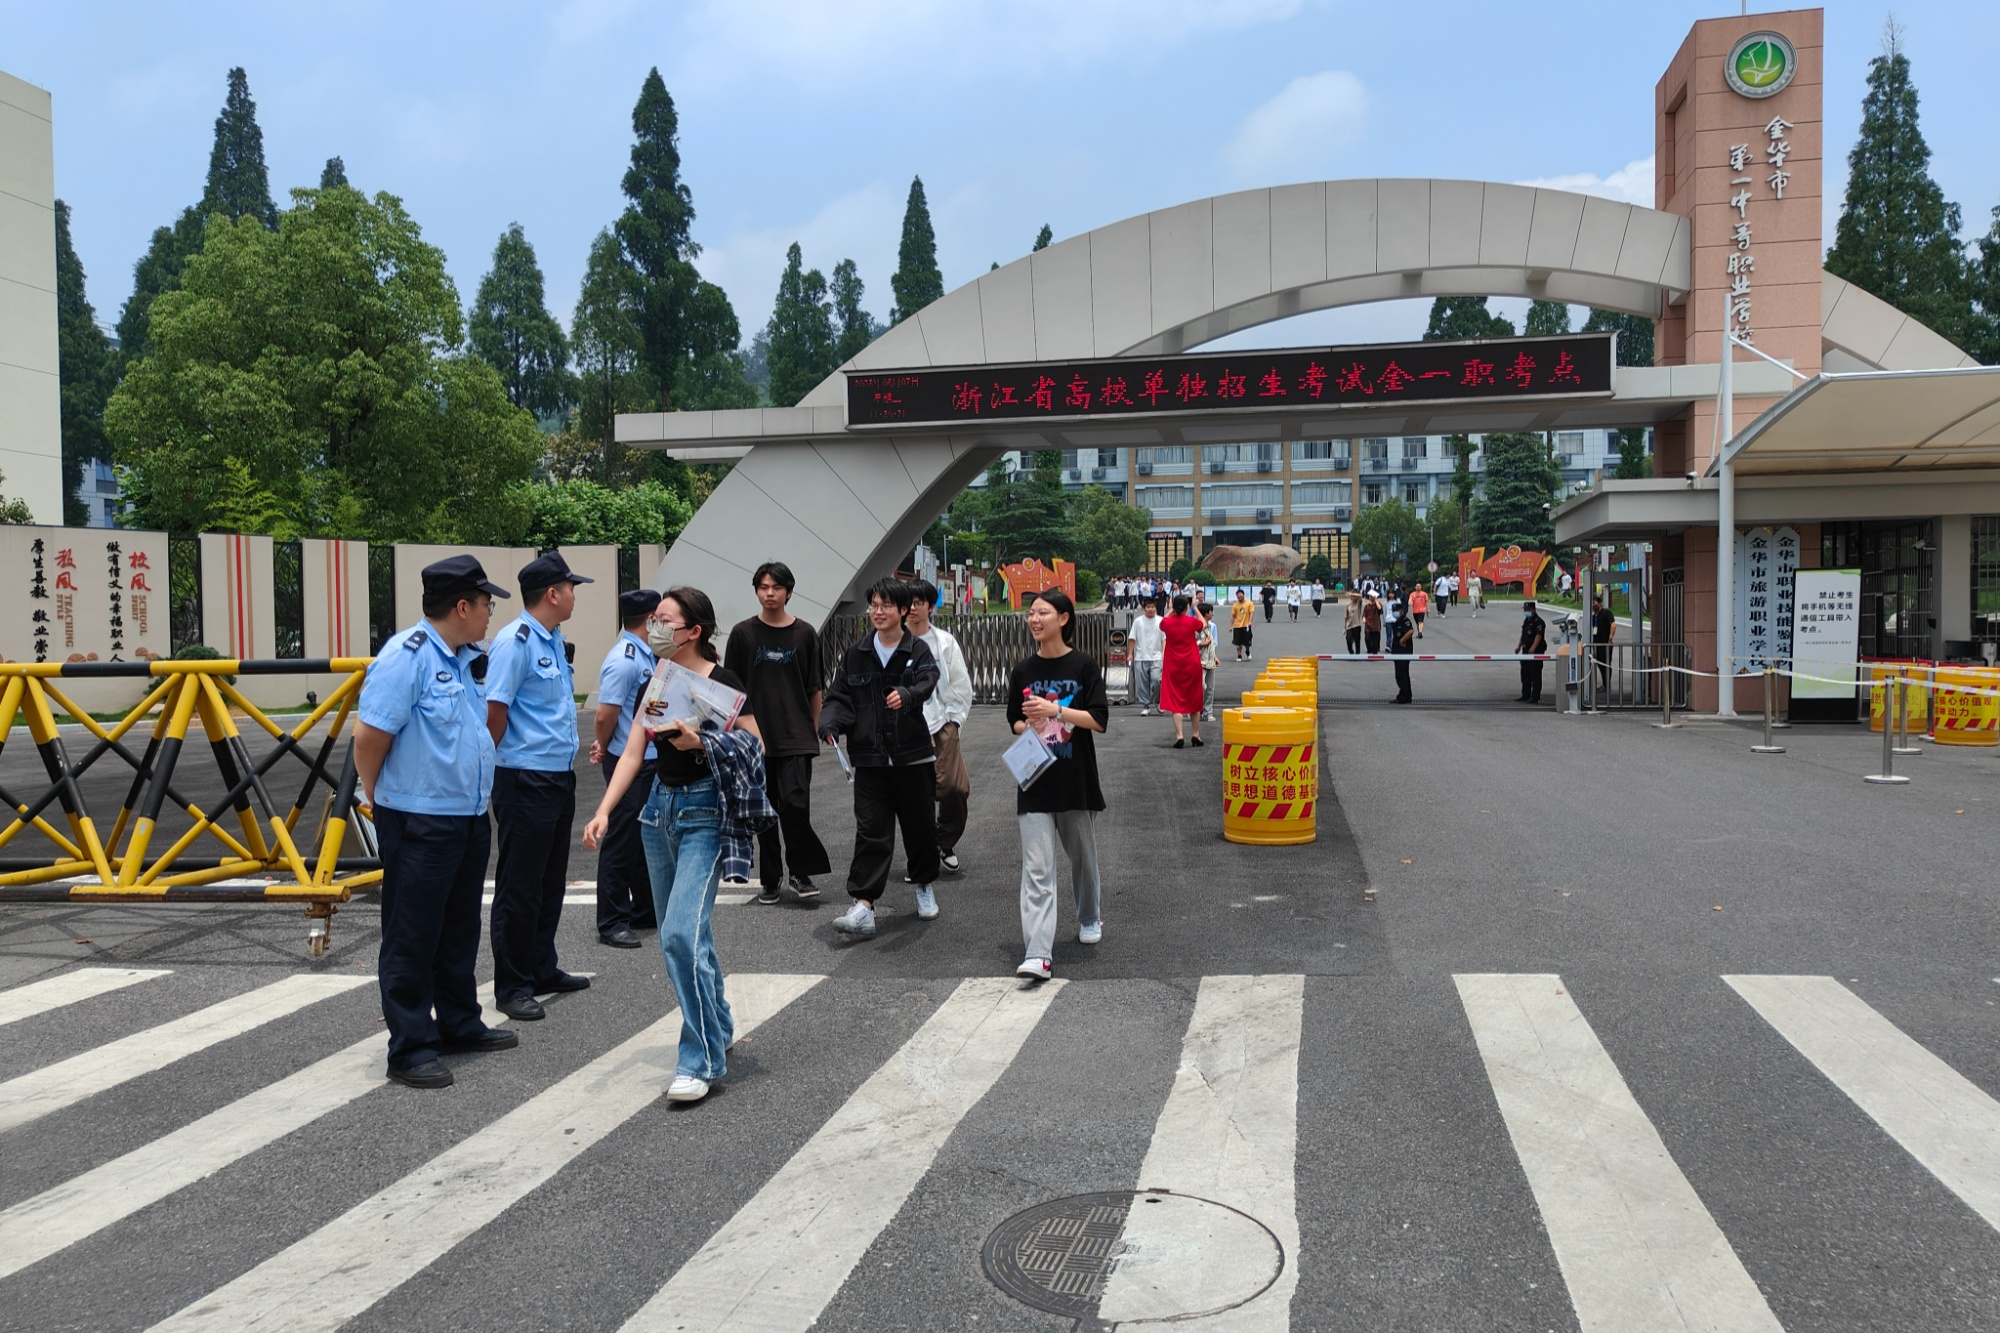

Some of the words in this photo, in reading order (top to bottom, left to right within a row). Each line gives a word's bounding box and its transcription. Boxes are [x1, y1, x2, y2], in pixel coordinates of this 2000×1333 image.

[1764, 115, 1794, 200] 金华市
[1727, 143, 1755, 346] 第一中等职业学校
[30, 538, 49, 599] 厚生善教
[54, 548, 78, 591] 教风
[128, 551, 151, 591] 校风
[1819, 591, 1853, 599] 禁止考生
[64, 594, 74, 648] TEACHING
[139, 595, 147, 635] SCHOOL
[1749, 537, 1768, 668] 金华市旅游职业学校
